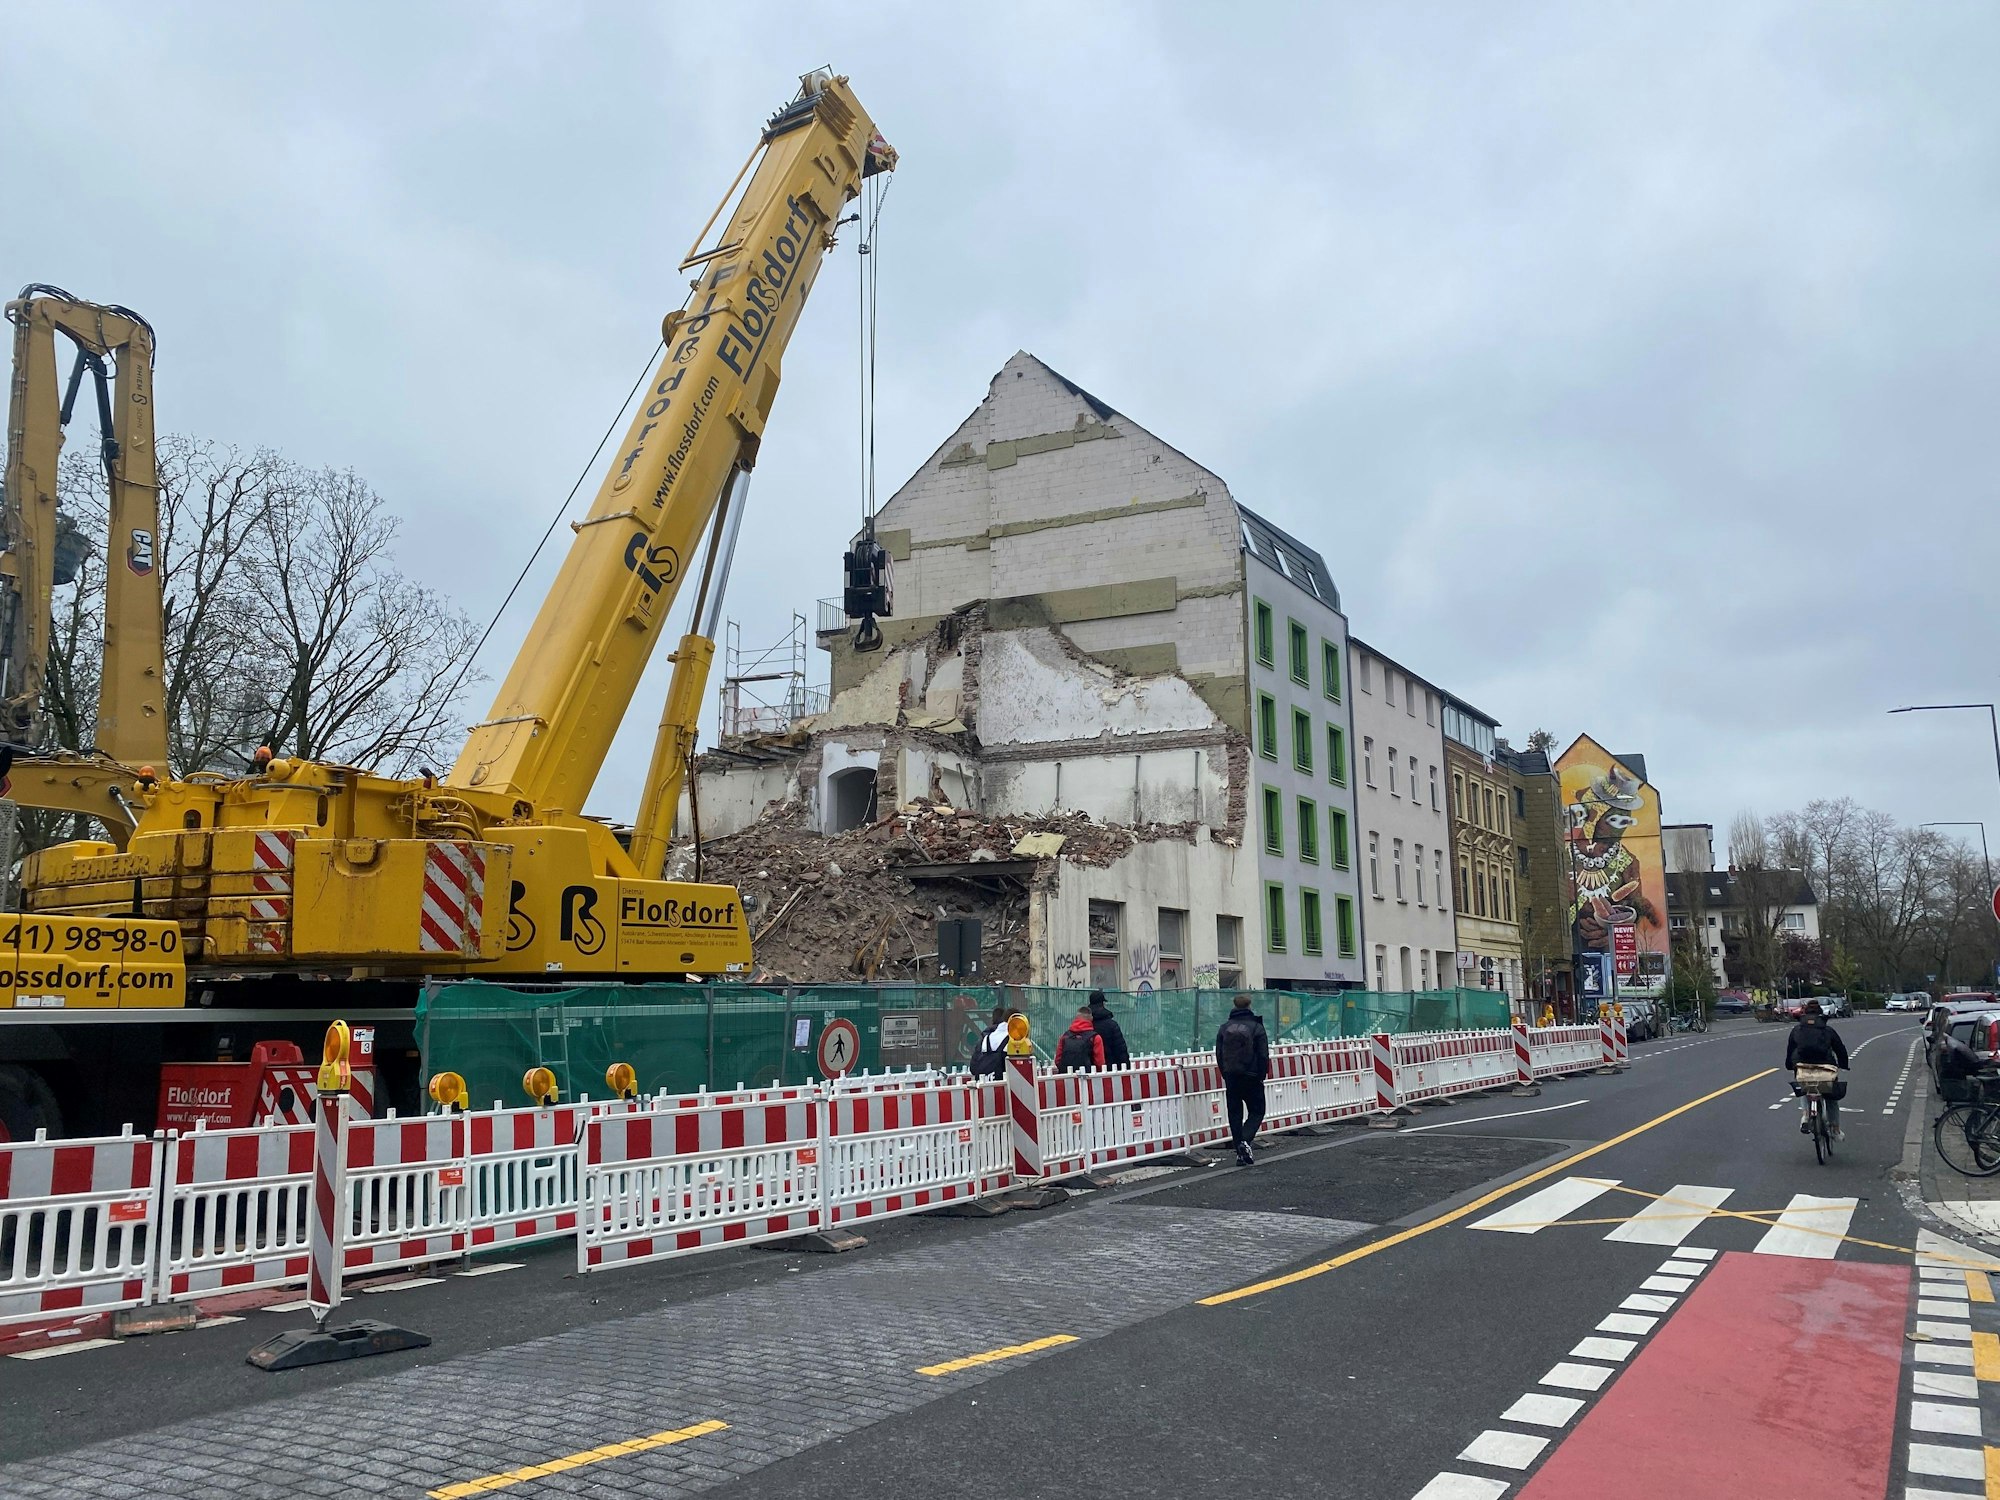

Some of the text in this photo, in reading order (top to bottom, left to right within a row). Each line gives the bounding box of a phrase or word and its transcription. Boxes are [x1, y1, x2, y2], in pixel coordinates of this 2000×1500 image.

[716, 194, 810, 376] Floßdorf
[652, 375, 720, 510] www.flossdorf.com
[132, 530, 153, 567] CAT
[621, 897, 734, 928] Floßdorf
[111, 928, 177, 953] 98-0
[167, 1087, 231, 1106] Floßdorf
